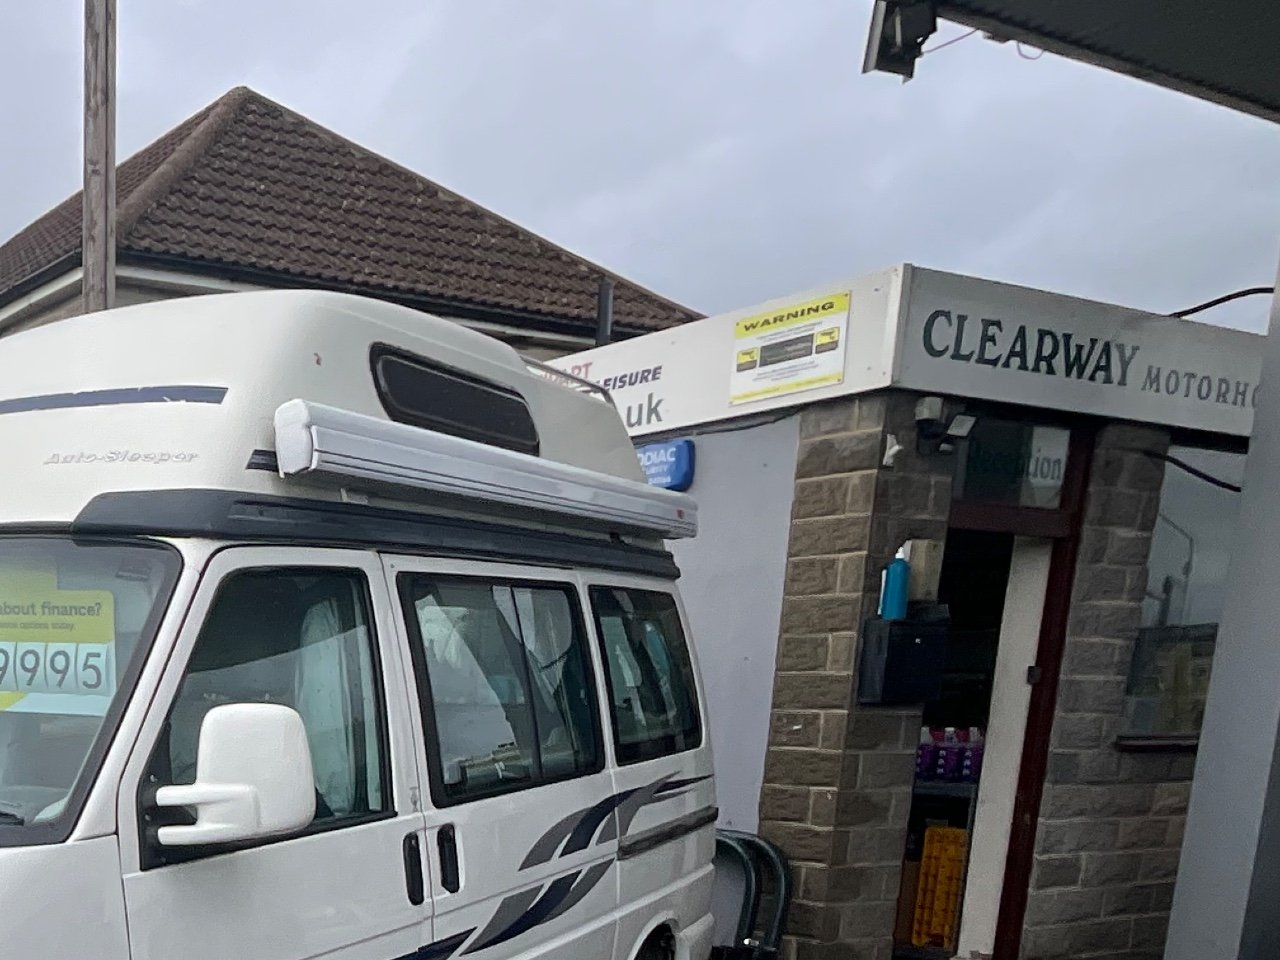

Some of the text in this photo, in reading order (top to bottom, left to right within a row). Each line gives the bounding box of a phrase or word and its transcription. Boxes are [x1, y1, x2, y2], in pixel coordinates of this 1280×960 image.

[743, 301, 835, 332] WARNING
[922, 309, 1140, 387] CLEARWAY
[597, 365, 662, 393] EISURE
[626, 392, 664, 428] uk
[41, 601, 102, 616] finance?
